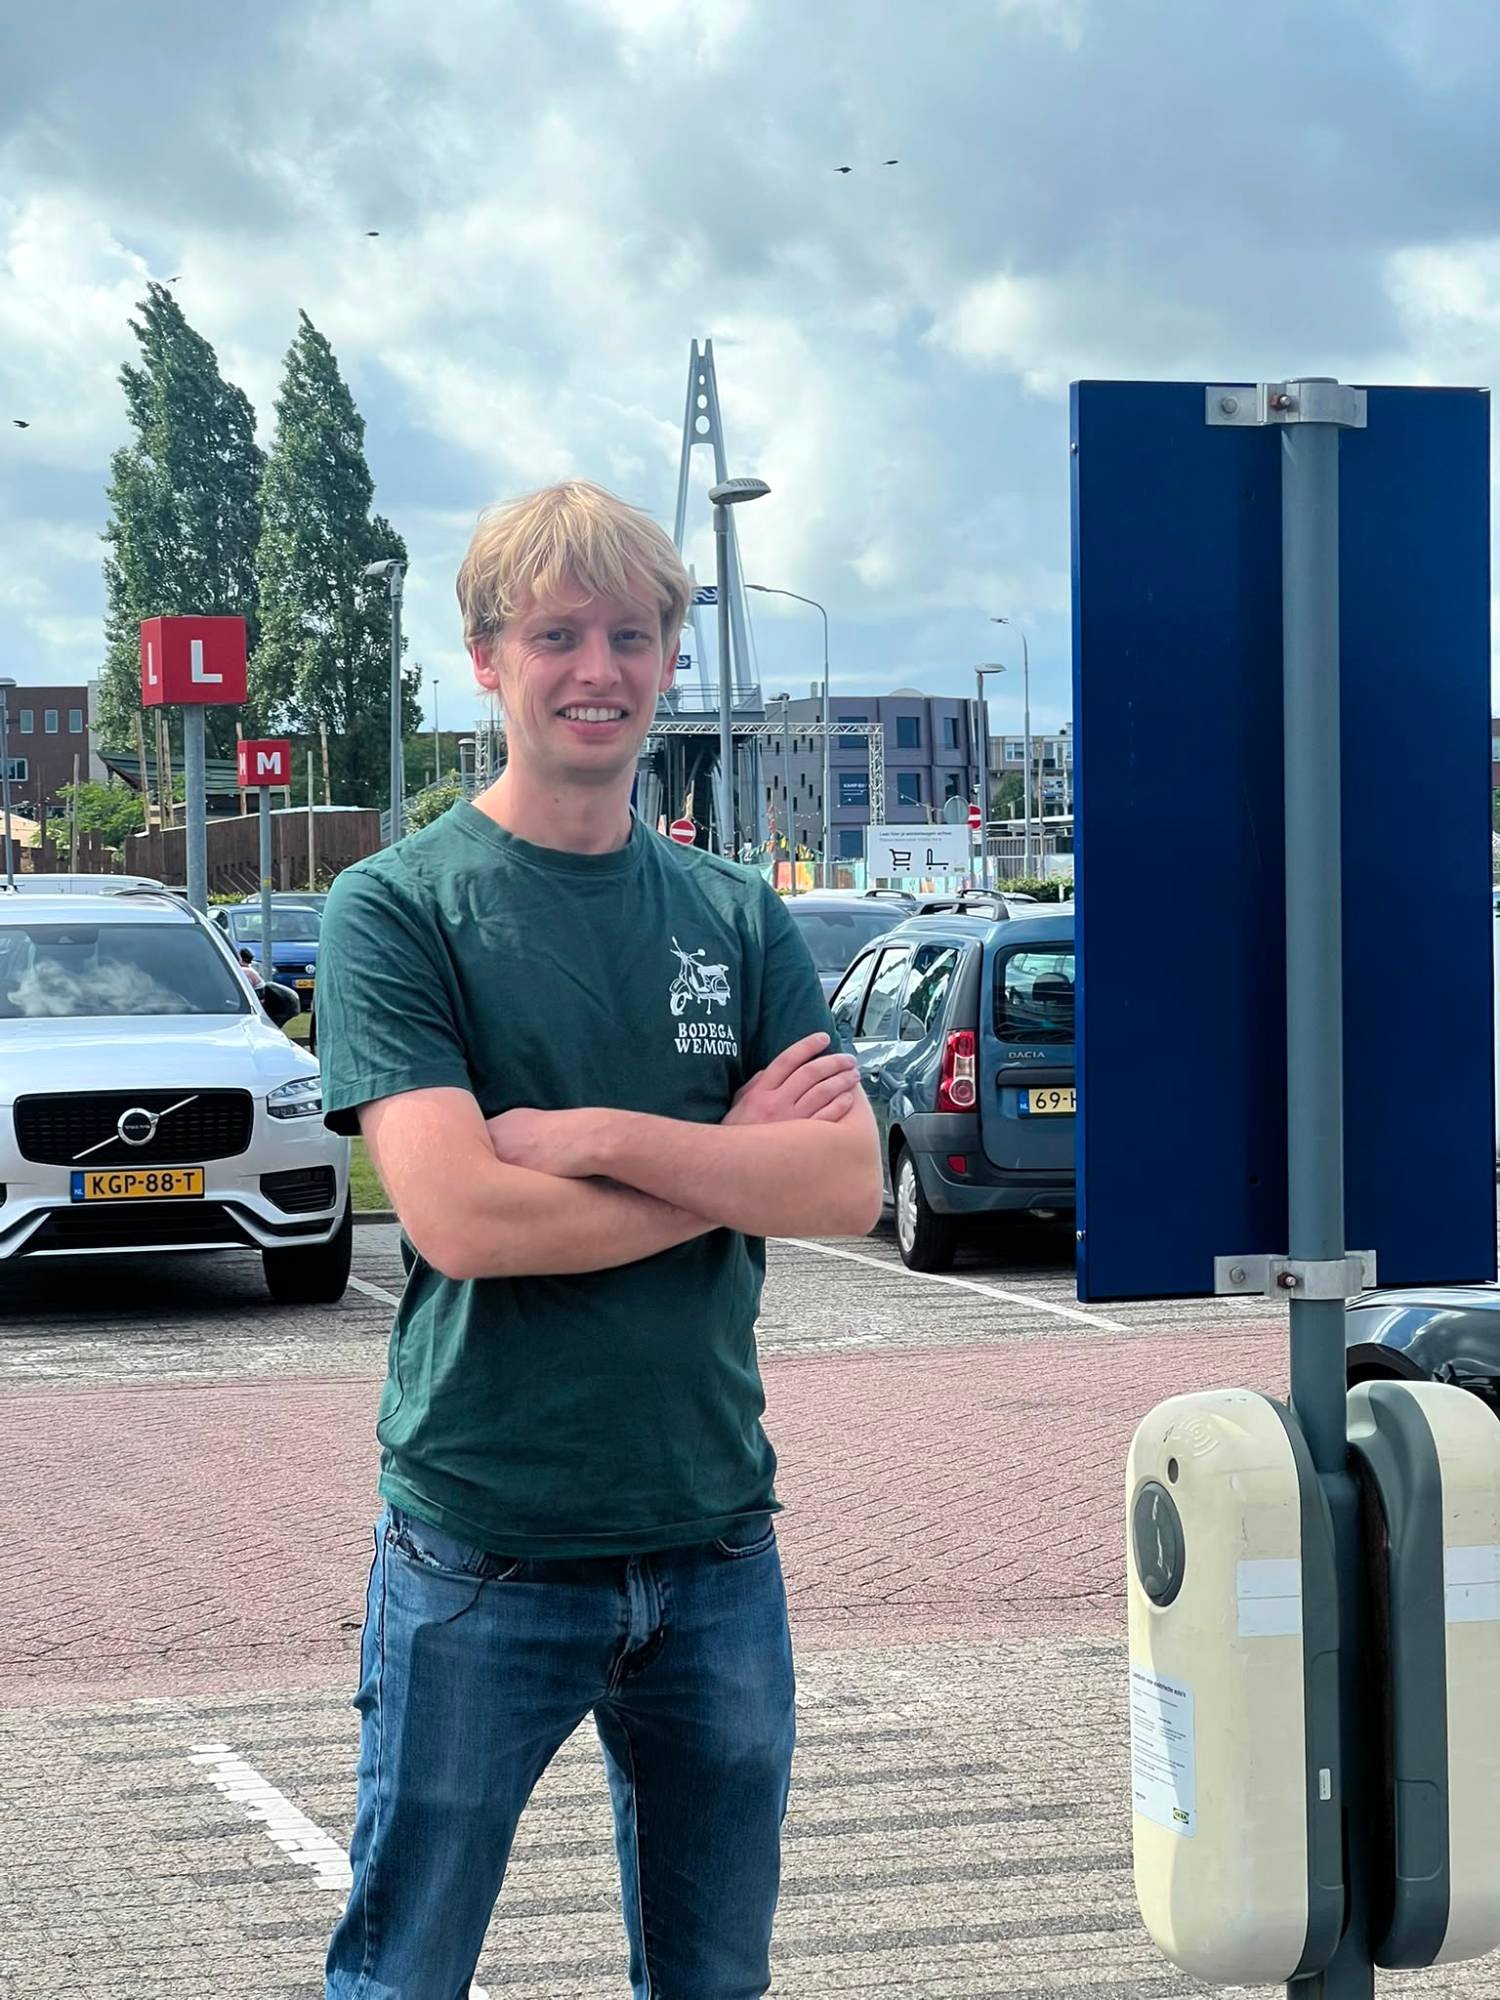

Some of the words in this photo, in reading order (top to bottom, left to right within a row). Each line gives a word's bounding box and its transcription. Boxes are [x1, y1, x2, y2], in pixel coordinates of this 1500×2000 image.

[190, 639, 223, 683] L
[257, 751, 282, 775] M
[678, 1022, 735, 1040] BODEGA
[674, 1038, 738, 1057] WEMOTO
[1008, 1051, 1045, 1059] DACIA
[92, 1172, 195, 1195] KGP-88-T
